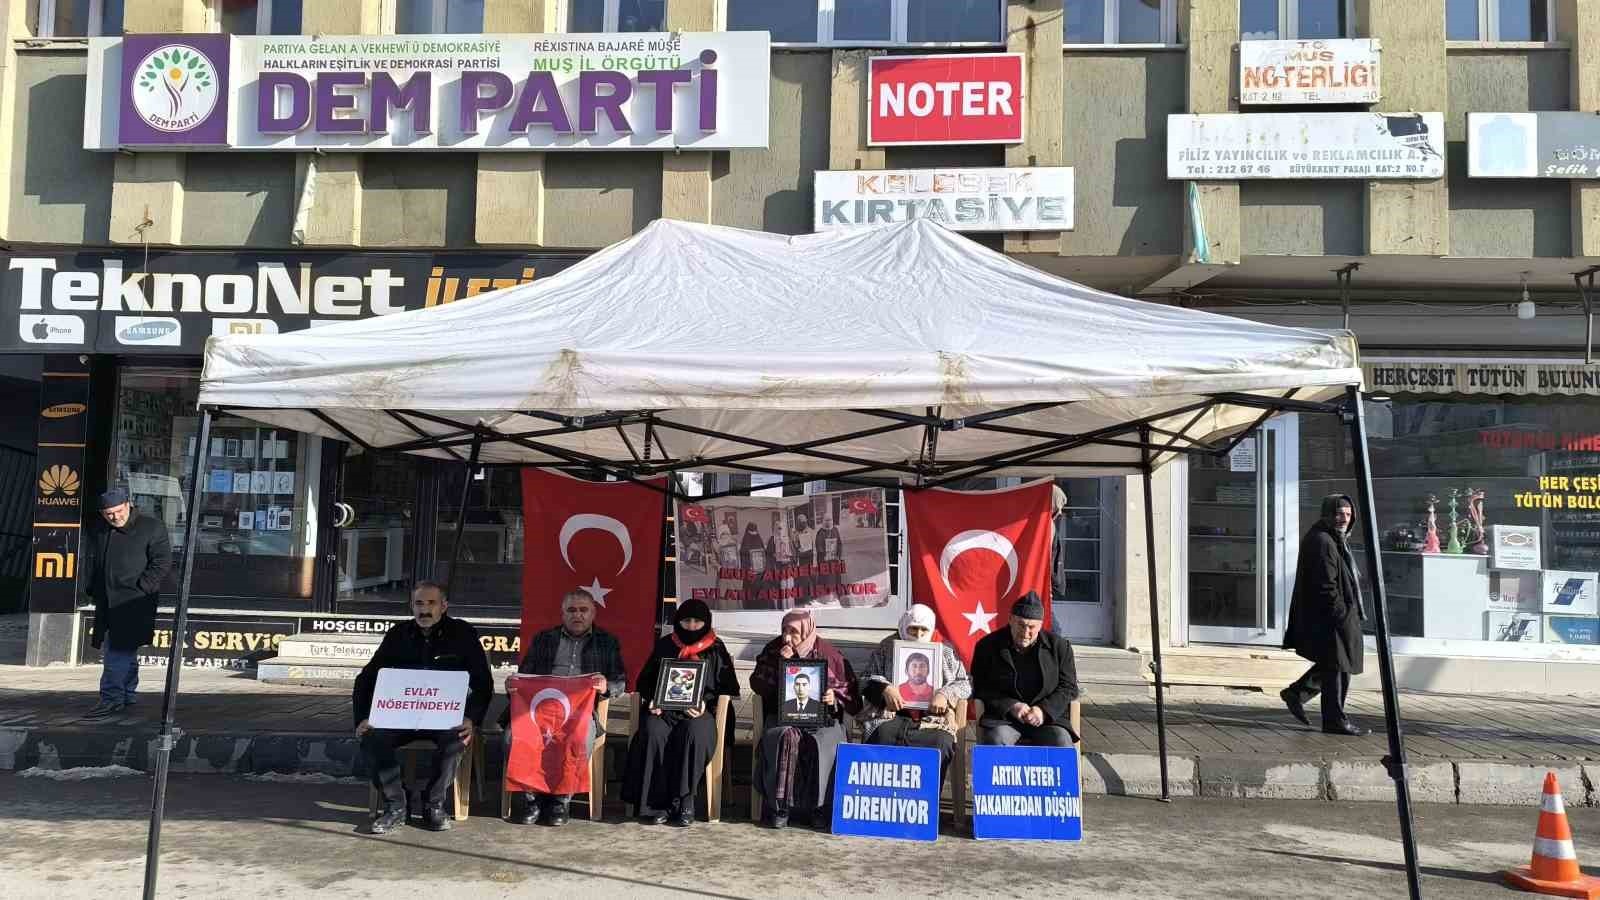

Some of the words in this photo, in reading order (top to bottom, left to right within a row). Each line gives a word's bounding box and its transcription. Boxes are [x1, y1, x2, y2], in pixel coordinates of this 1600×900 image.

[310, 44, 347, 54] GELAN
[350, 43, 358, 54] A
[264, 59, 327, 69] HALKLARIN
[330, 58, 371, 71] EŞİTLİK
[374, 60, 387, 69] VE
[390, 58, 453, 69] DEMOKRASİ
[457, 57, 501, 68] PARTİSİ
[534, 57, 573, 73] MUŞ
[580, 54, 595, 71] İL
[602, 54, 681, 71] ÖRGÜTÜ
[258, 71, 432, 134] DEM
[460, 49, 718, 134] PARTİ
[879, 81, 1014, 118] NOTER
[149, 113, 170, 128] DEM
[170, 111, 199, 129] PARTİ
[1215, 149, 1288, 161] YAYINCILIK
[1186, 165, 1205, 174] Tel
[1217, 165, 1237, 174] 212
[1545, 163, 1589, 178] Şefik
[822, 194, 1066, 224] KIRTASİYE
[8, 257, 406, 316] TeknoNet
[49, 327, 72, 335] iPhone
[126, 326, 171, 337] SAMSUNG
[1467, 364, 1526, 388] TÜTÜN
[1540, 476, 1569, 491] HER
[37, 497, 80, 506] HUAWEI
[1514, 492, 1563, 508] TÜTÜN
[404, 687, 440, 697] EVLAT
[377, 698, 460, 711] NÖBETİNDEYİZ
[847, 761, 921, 789] ANNELER
[991, 765, 1022, 787] ARTIK
[1024, 766, 1054, 787] YETER
[842, 789, 929, 825] DİRENİYOR
[974, 794, 1042, 817] YAKAMIZDAN
[1044, 791, 1080, 823] DÜŞÜN
